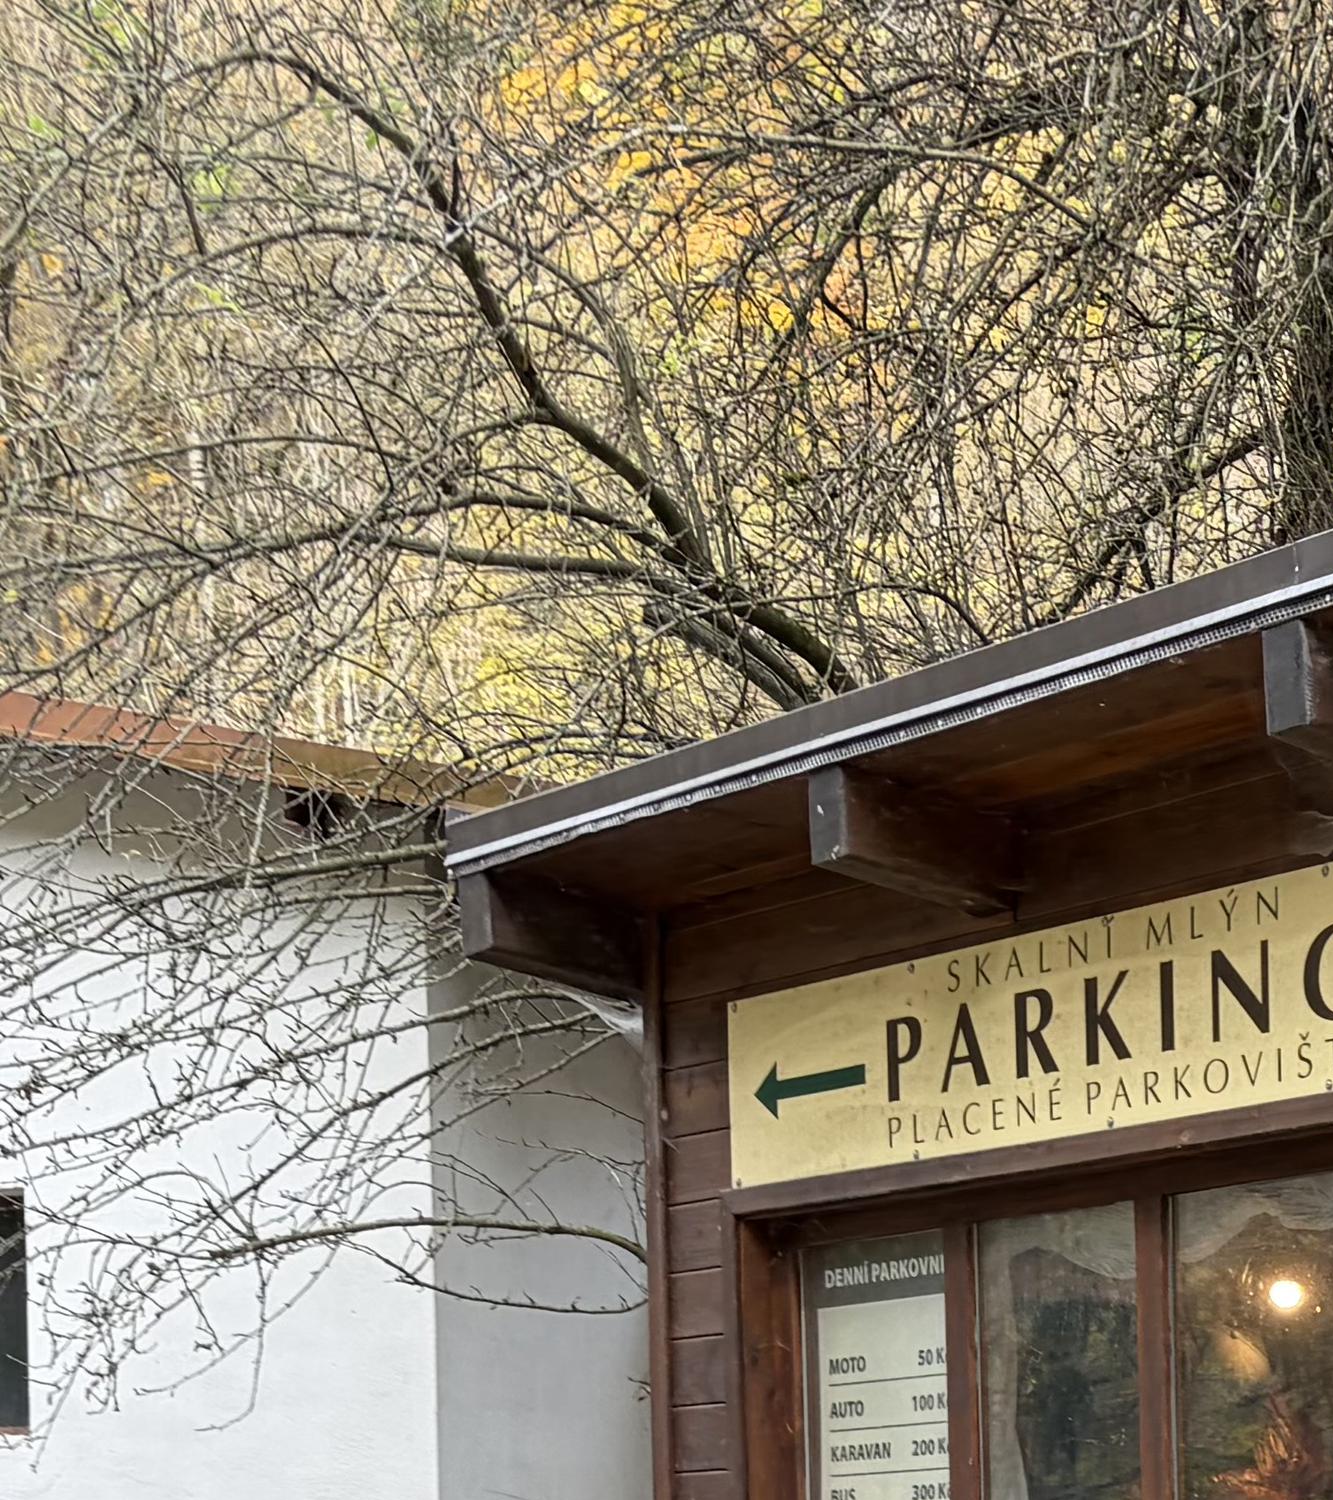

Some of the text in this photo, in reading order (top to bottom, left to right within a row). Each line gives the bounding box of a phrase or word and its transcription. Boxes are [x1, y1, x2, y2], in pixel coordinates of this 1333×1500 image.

[946, 885, 1282, 993] SKALNÍ MLÝN
[888, 1077, 1062, 1148] PLACENÉ
[824, 1254, 944, 1288] DENNÍ PARKOVN
[828, 1347, 946, 1375] MOTO 50 K
[829, 1392, 947, 1419] AUTO 100 K
[830, 1438, 949, 1462] KARAVAN 200 K
[912, 1485, 935, 1500] 300
